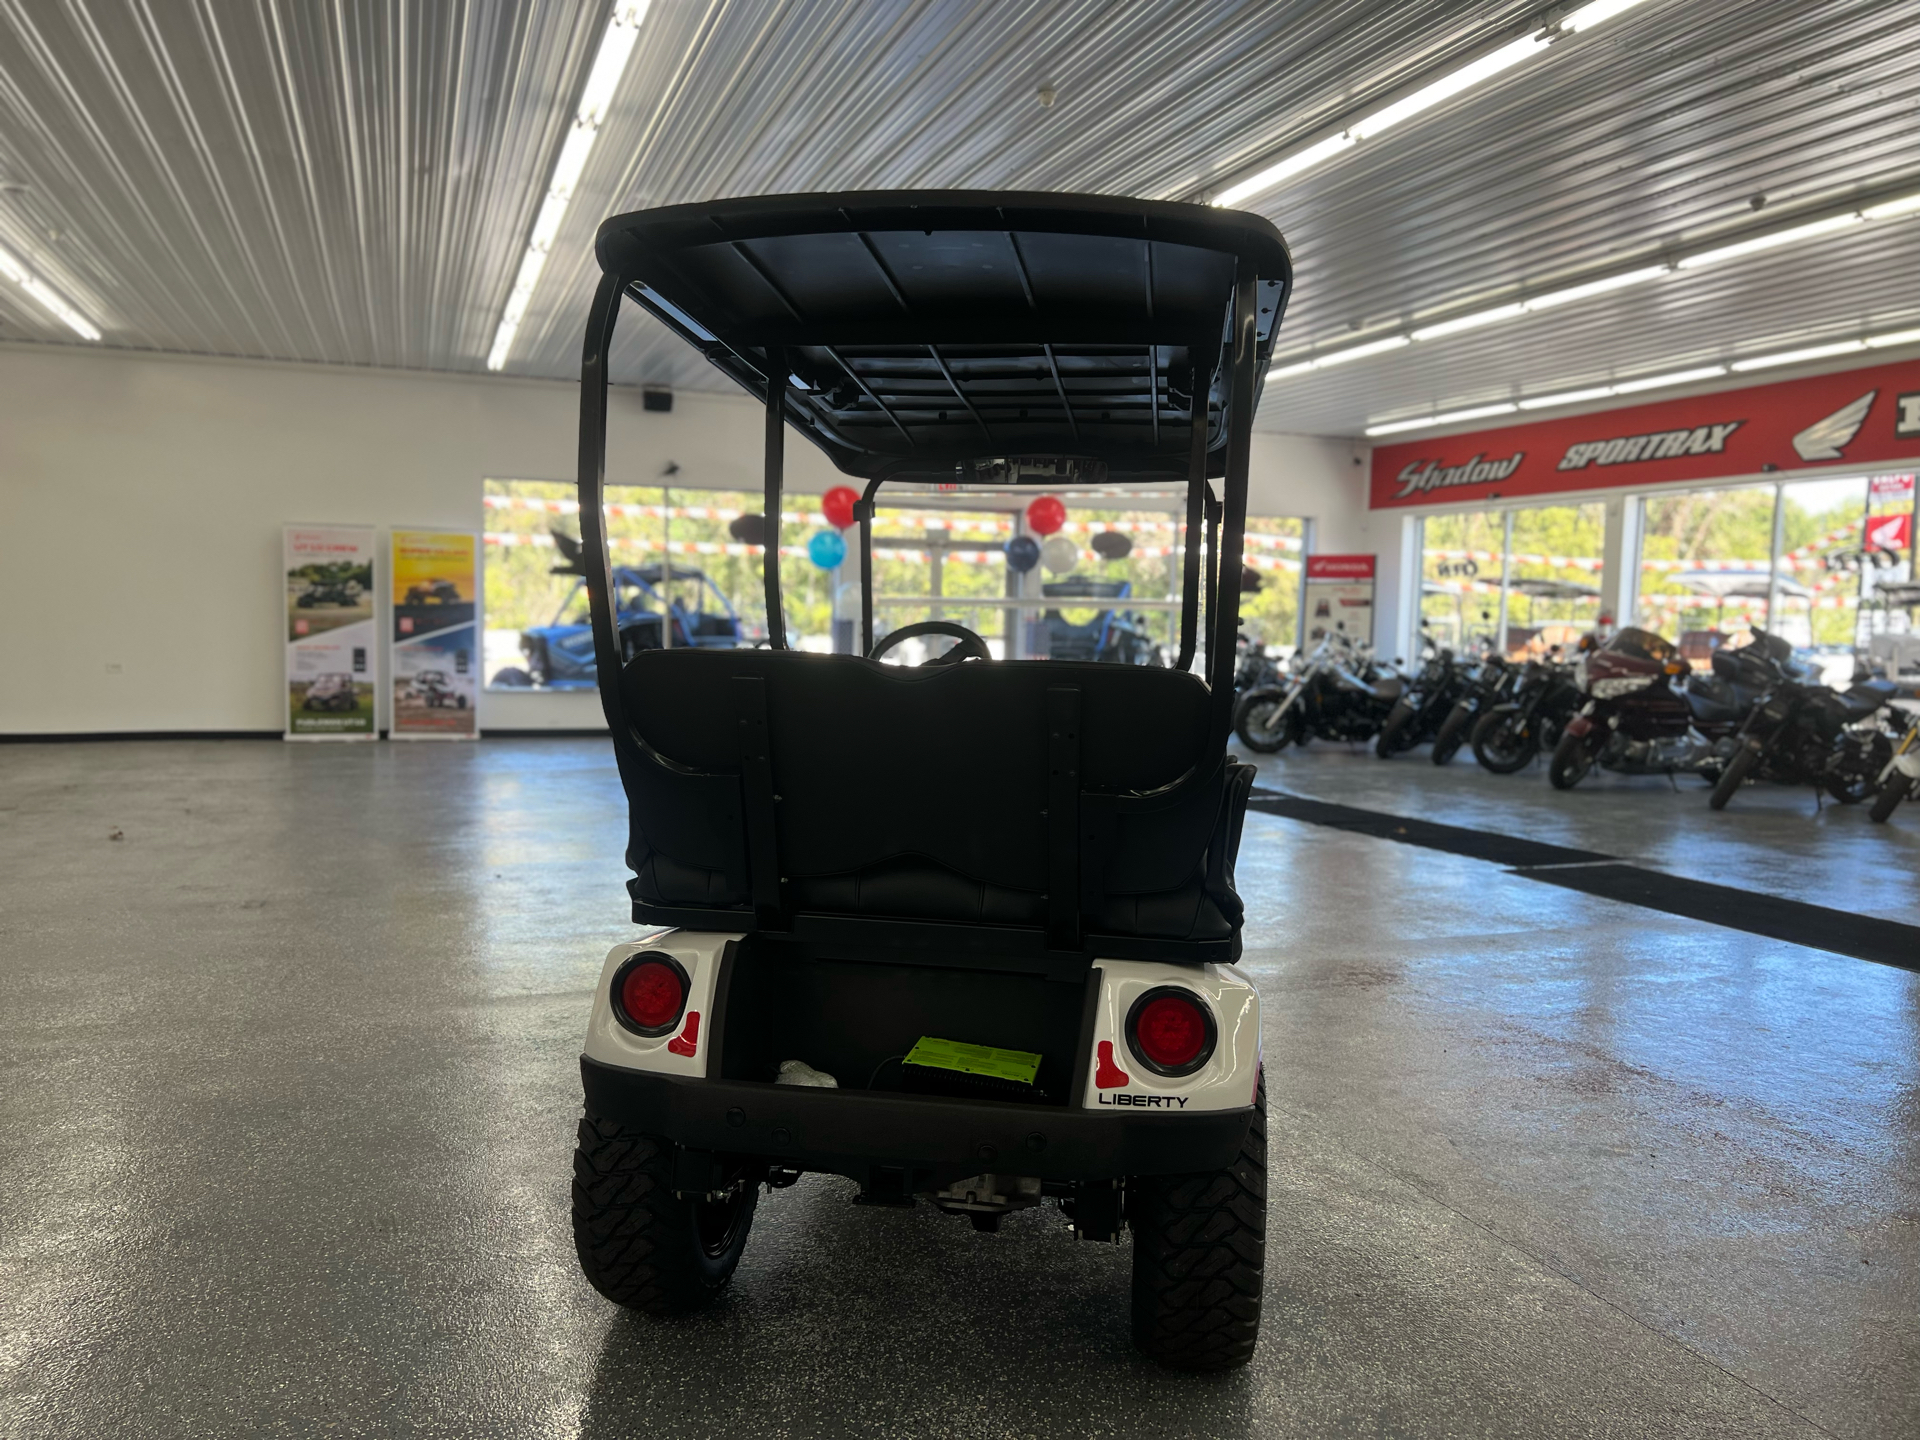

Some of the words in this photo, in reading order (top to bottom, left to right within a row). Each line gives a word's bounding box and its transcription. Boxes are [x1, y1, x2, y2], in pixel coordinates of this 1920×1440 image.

[1557, 420, 1745, 470] SPORTRAX
[1392, 452, 1525, 498] Shadow
[1098, 1092, 1189, 1108] LIBERTY
